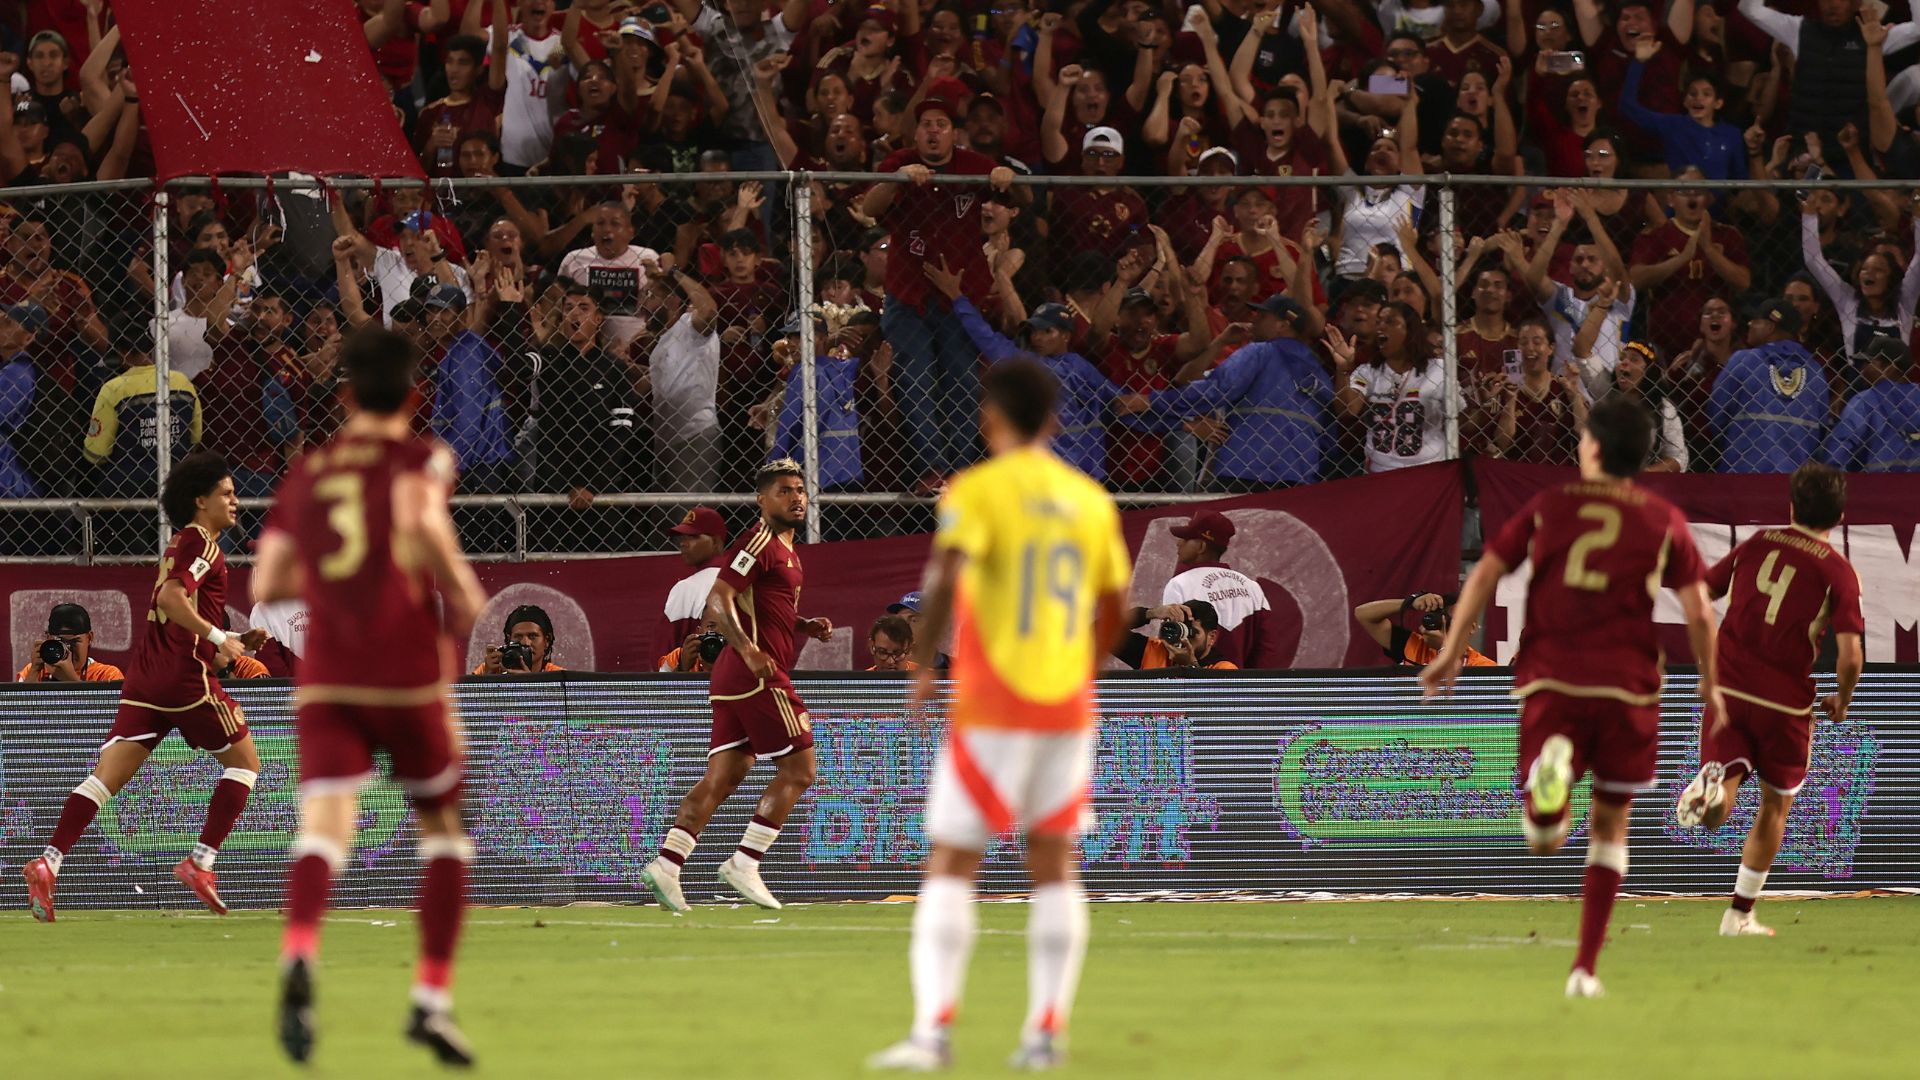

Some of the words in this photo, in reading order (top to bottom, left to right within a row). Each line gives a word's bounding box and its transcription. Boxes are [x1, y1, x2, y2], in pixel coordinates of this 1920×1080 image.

[594, 269, 633, 279] TOMMY
[591, 278, 636, 287] HILFIGER
[140, 415, 180, 427] BOMOS
[140, 425, 180, 437] FOREES
[313, 472, 370, 580] 3
[1563, 503, 1622, 591] 2
[1018, 540, 1085, 642] 19
[1756, 549, 1797, 626] 4
[1207, 588, 1250, 602] BOLIVARIANA
